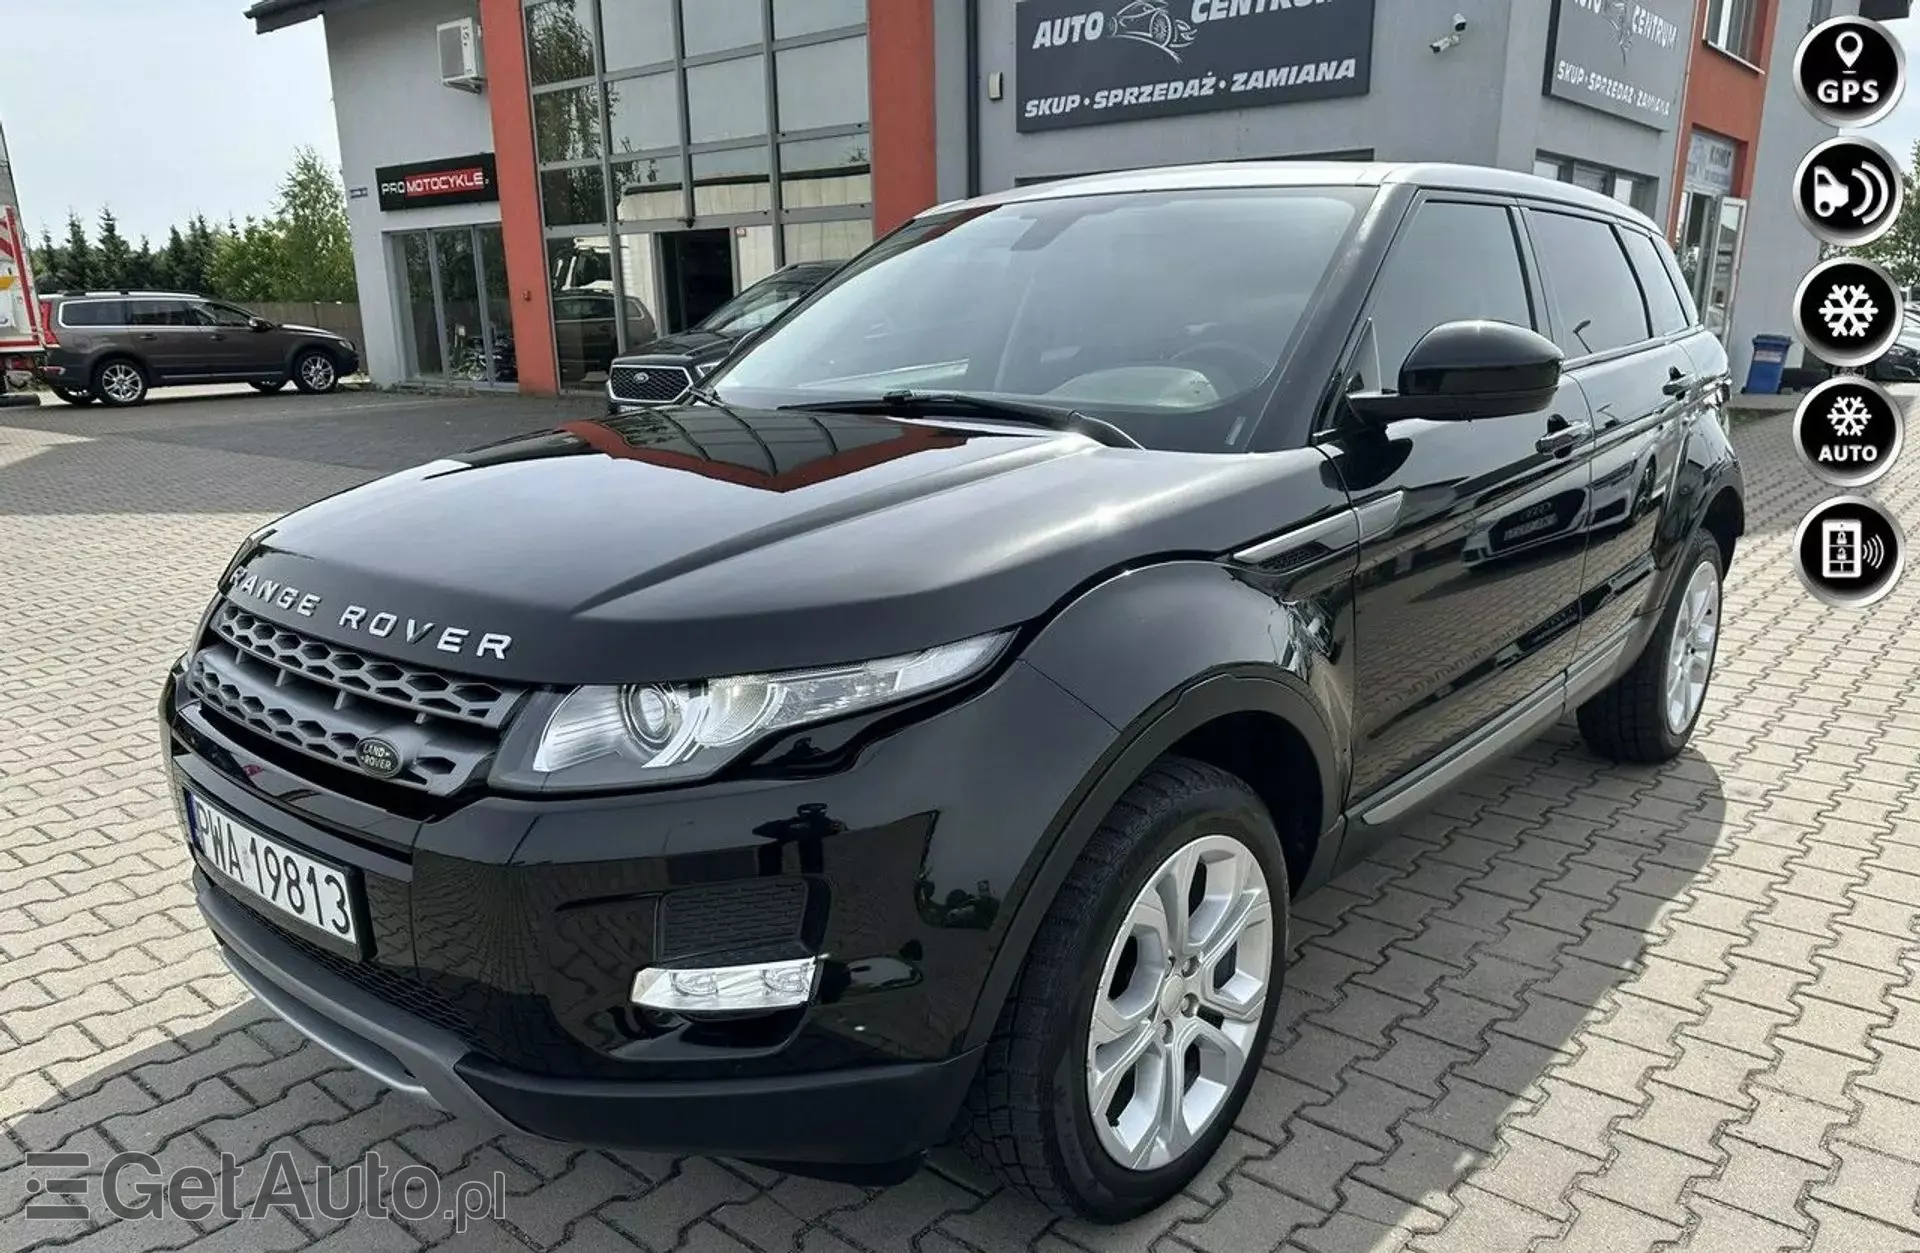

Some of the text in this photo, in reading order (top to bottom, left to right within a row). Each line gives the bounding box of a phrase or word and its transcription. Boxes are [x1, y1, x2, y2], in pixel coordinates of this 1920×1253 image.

[1032, 0, 1332, 49] AUTO CENT
[1024, 58, 1356, 118] SKUP SPRZEDAŻ ZAMIANA
[1557, 60, 1585, 85] SKUP
[229, 565, 513, 660] RANGE ROVER
[363, 743, 385, 757] LAND
[365, 755, 391, 769] ROVER
[195, 800, 351, 935] PWA 19813
